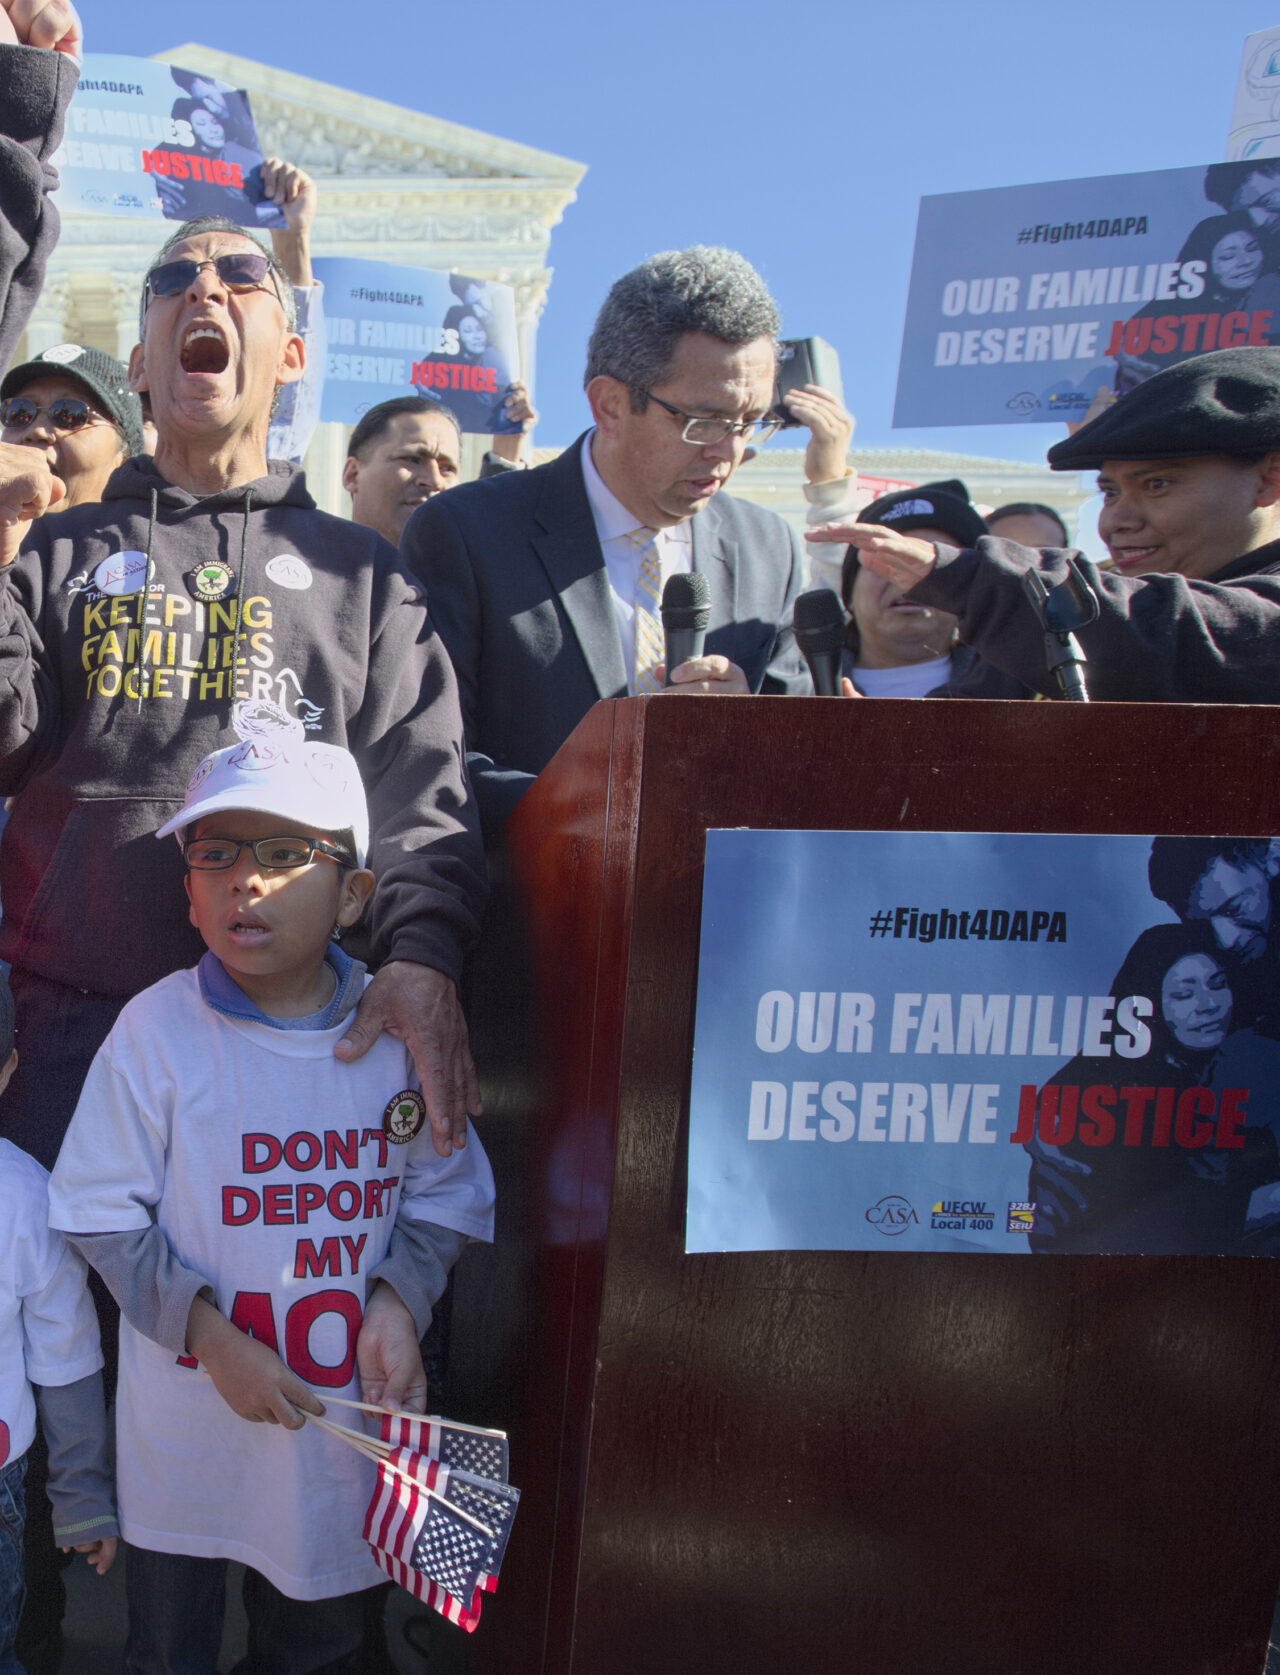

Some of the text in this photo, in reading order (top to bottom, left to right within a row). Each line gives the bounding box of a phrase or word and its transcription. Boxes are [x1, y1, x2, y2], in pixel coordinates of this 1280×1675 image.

[77, 80, 144, 96] ght4DAPA
[74, 107, 196, 147] FAMILIES
[141, 150, 245, 188] JUSTICE
[1017, 216, 1148, 245] #Fight4DAPA
[350, 287, 424, 307] #Fight4DAPA
[941, 260, 1207, 317] OUR FAMILIES
[326, 317, 460, 355] UR FAMILIES
[933, 310, 1273, 367] DESERVE JUSTICE
[326, 353, 497, 393] ESERVE JUSTICE
[83, 593, 273, 636] KEEPING
[193, 591, 227, 601] AMERICA
[81, 628, 274, 671] FAMILIES
[86, 664, 273, 700] TOGETHER
[870, 907, 1067, 943] #Fight4DAPA
[755, 990, 1154, 1059] OUR FAMILIES
[747, 1080, 1251, 1150] DESERVE JUSTICE
[242, 1128, 389, 1174] DON'T
[222, 1177, 400, 1226] DEPORT
[865, 1207, 920, 1224] CASA
[1009, 1202, 1036, 1211] 32BJ
[931, 1219, 994, 1230] Local 400
[293, 1233, 368, 1279] MY
